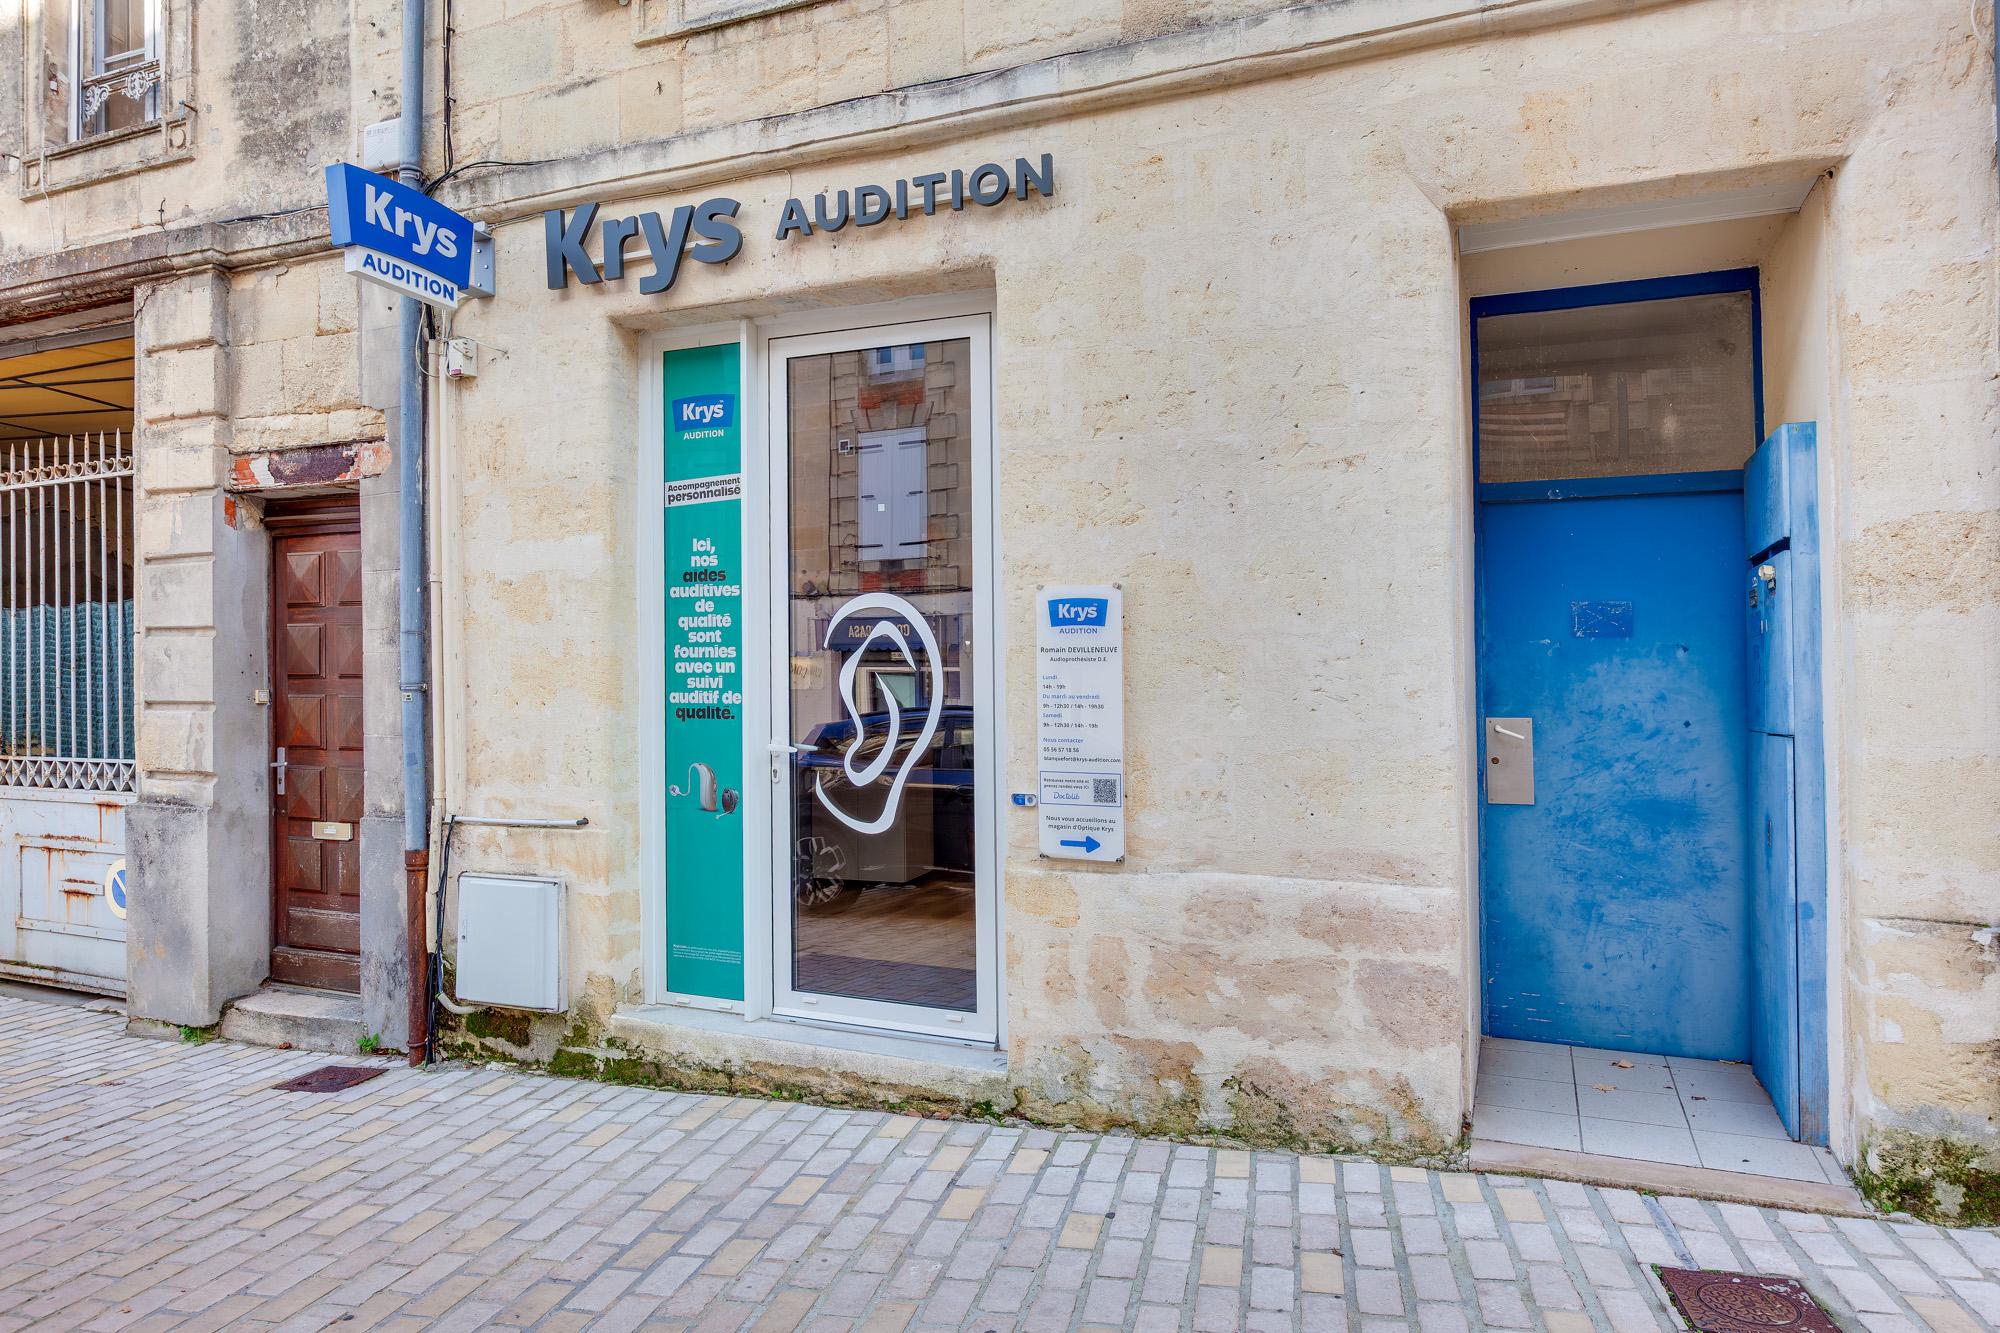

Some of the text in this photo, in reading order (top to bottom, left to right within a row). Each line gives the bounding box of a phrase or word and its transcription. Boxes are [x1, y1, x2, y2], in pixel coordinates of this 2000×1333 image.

[365, 183, 457, 258] Krys
[544, 153, 1054, 295] Krys AUDITION
[362, 253, 454, 301] AUDITION
[682, 402, 724, 423] Krys
[683, 429, 724, 440] AUDITION
[668, 477, 740, 492] Accompagnement
[668, 485, 741, 505] personnalisé
[692, 538, 715, 553] Ici,
[690, 554, 718, 567] nos
[682, 568, 726, 582] aides
[670, 583, 740, 598] auditives
[695, 599, 714, 612] de
[1058, 603, 1098, 621] Krys
[678, 613, 732, 630] qualité
[688, 629, 722, 643] sont
[674, 644, 736, 658] fournies
[675, 661, 735, 673] avec un
[687, 675, 723, 689] suivi
[669, 690, 742, 704] auditif de
[675, 705, 735, 721] qualité.
[1053, 791, 1080, 800] Doctolib
